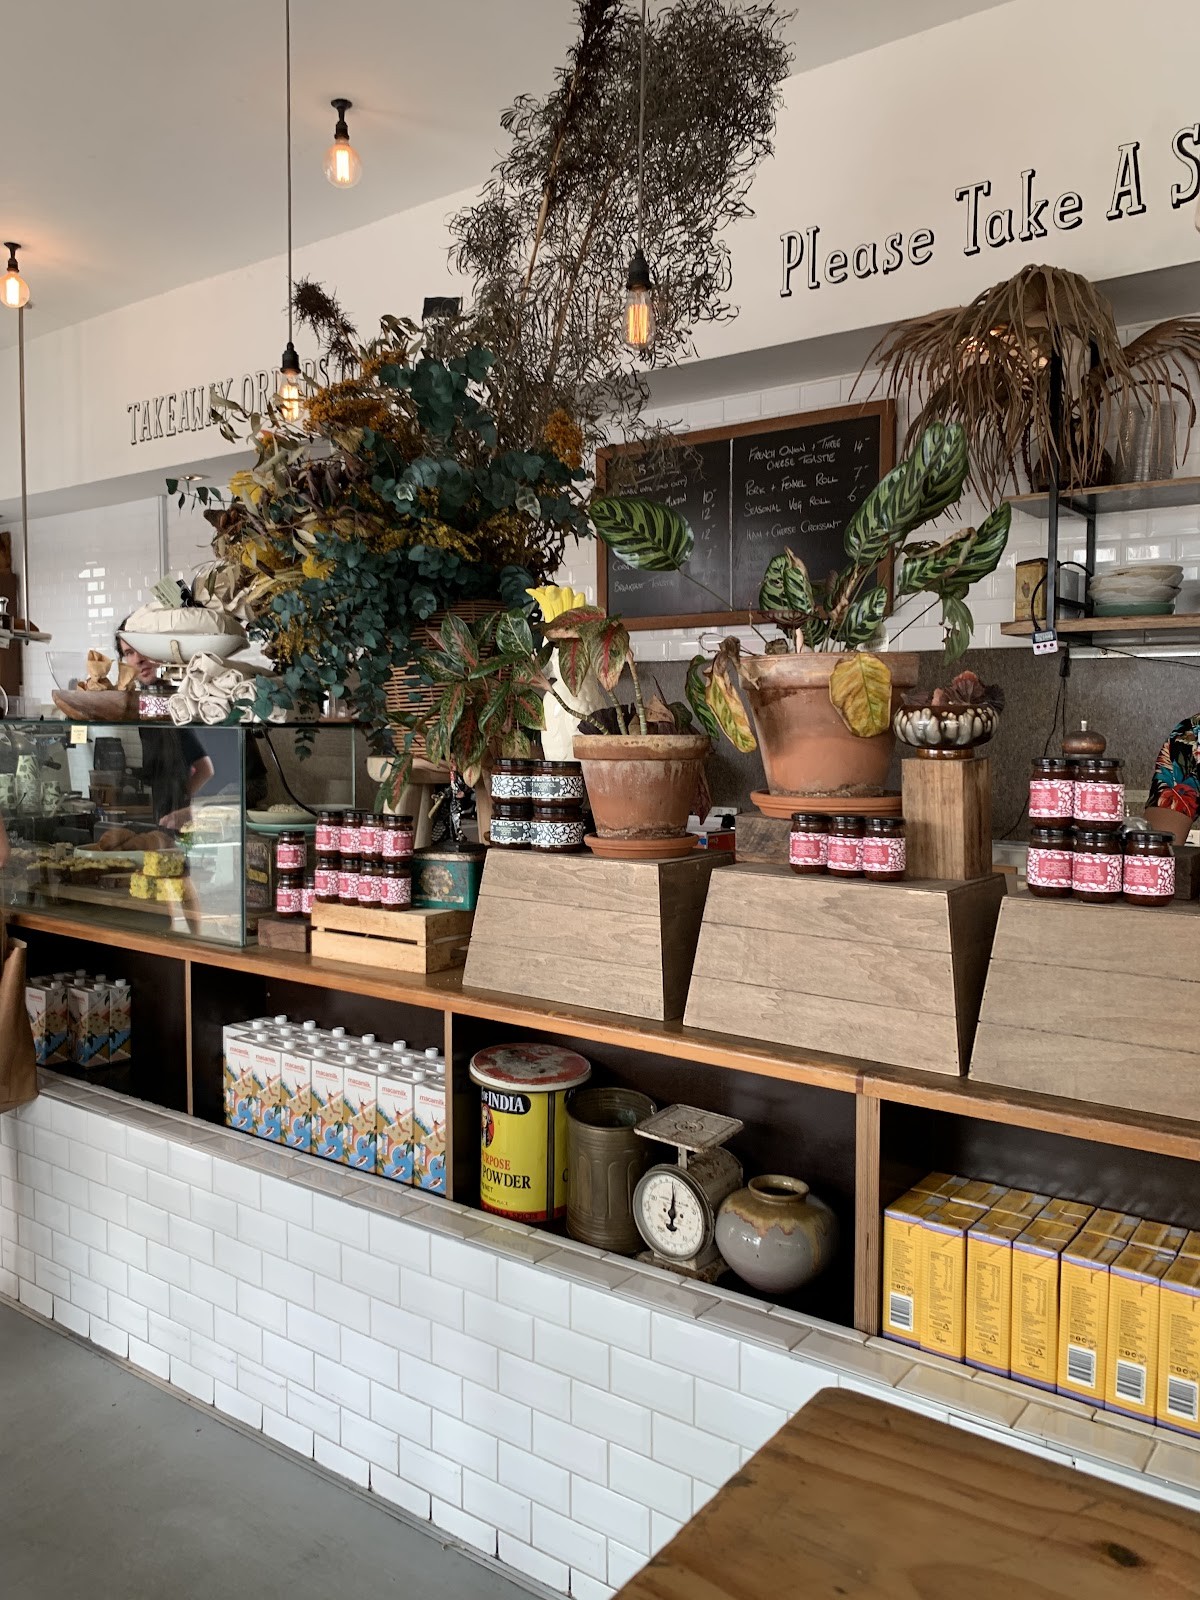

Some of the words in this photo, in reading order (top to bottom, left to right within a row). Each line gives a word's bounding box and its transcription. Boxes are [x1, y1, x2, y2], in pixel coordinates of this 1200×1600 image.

[779, 226, 935, 298] Please
[955, 169, 1083, 257] Take
[1106, 141, 1147, 220] A
[241, 355, 330, 418] ORRS
[817, 435, 842, 449] THREE
[745, 479, 767, 497] PORK
[781, 476, 807, 491] FENNEL
[815, 472, 839, 487] ROLL
[744, 502, 781, 517] SEASONAL
[809, 496, 832, 507] ROLL
[745, 528, 763, 541] HAM
[771, 524, 797, 538] CHEESE
[800, 520, 842, 534] CROISSANT
[488, 1091, 525, 1112] INDIA
[482, 1150, 511, 1170] URPOSE
[482, 1165, 532, 1189] POWDER
